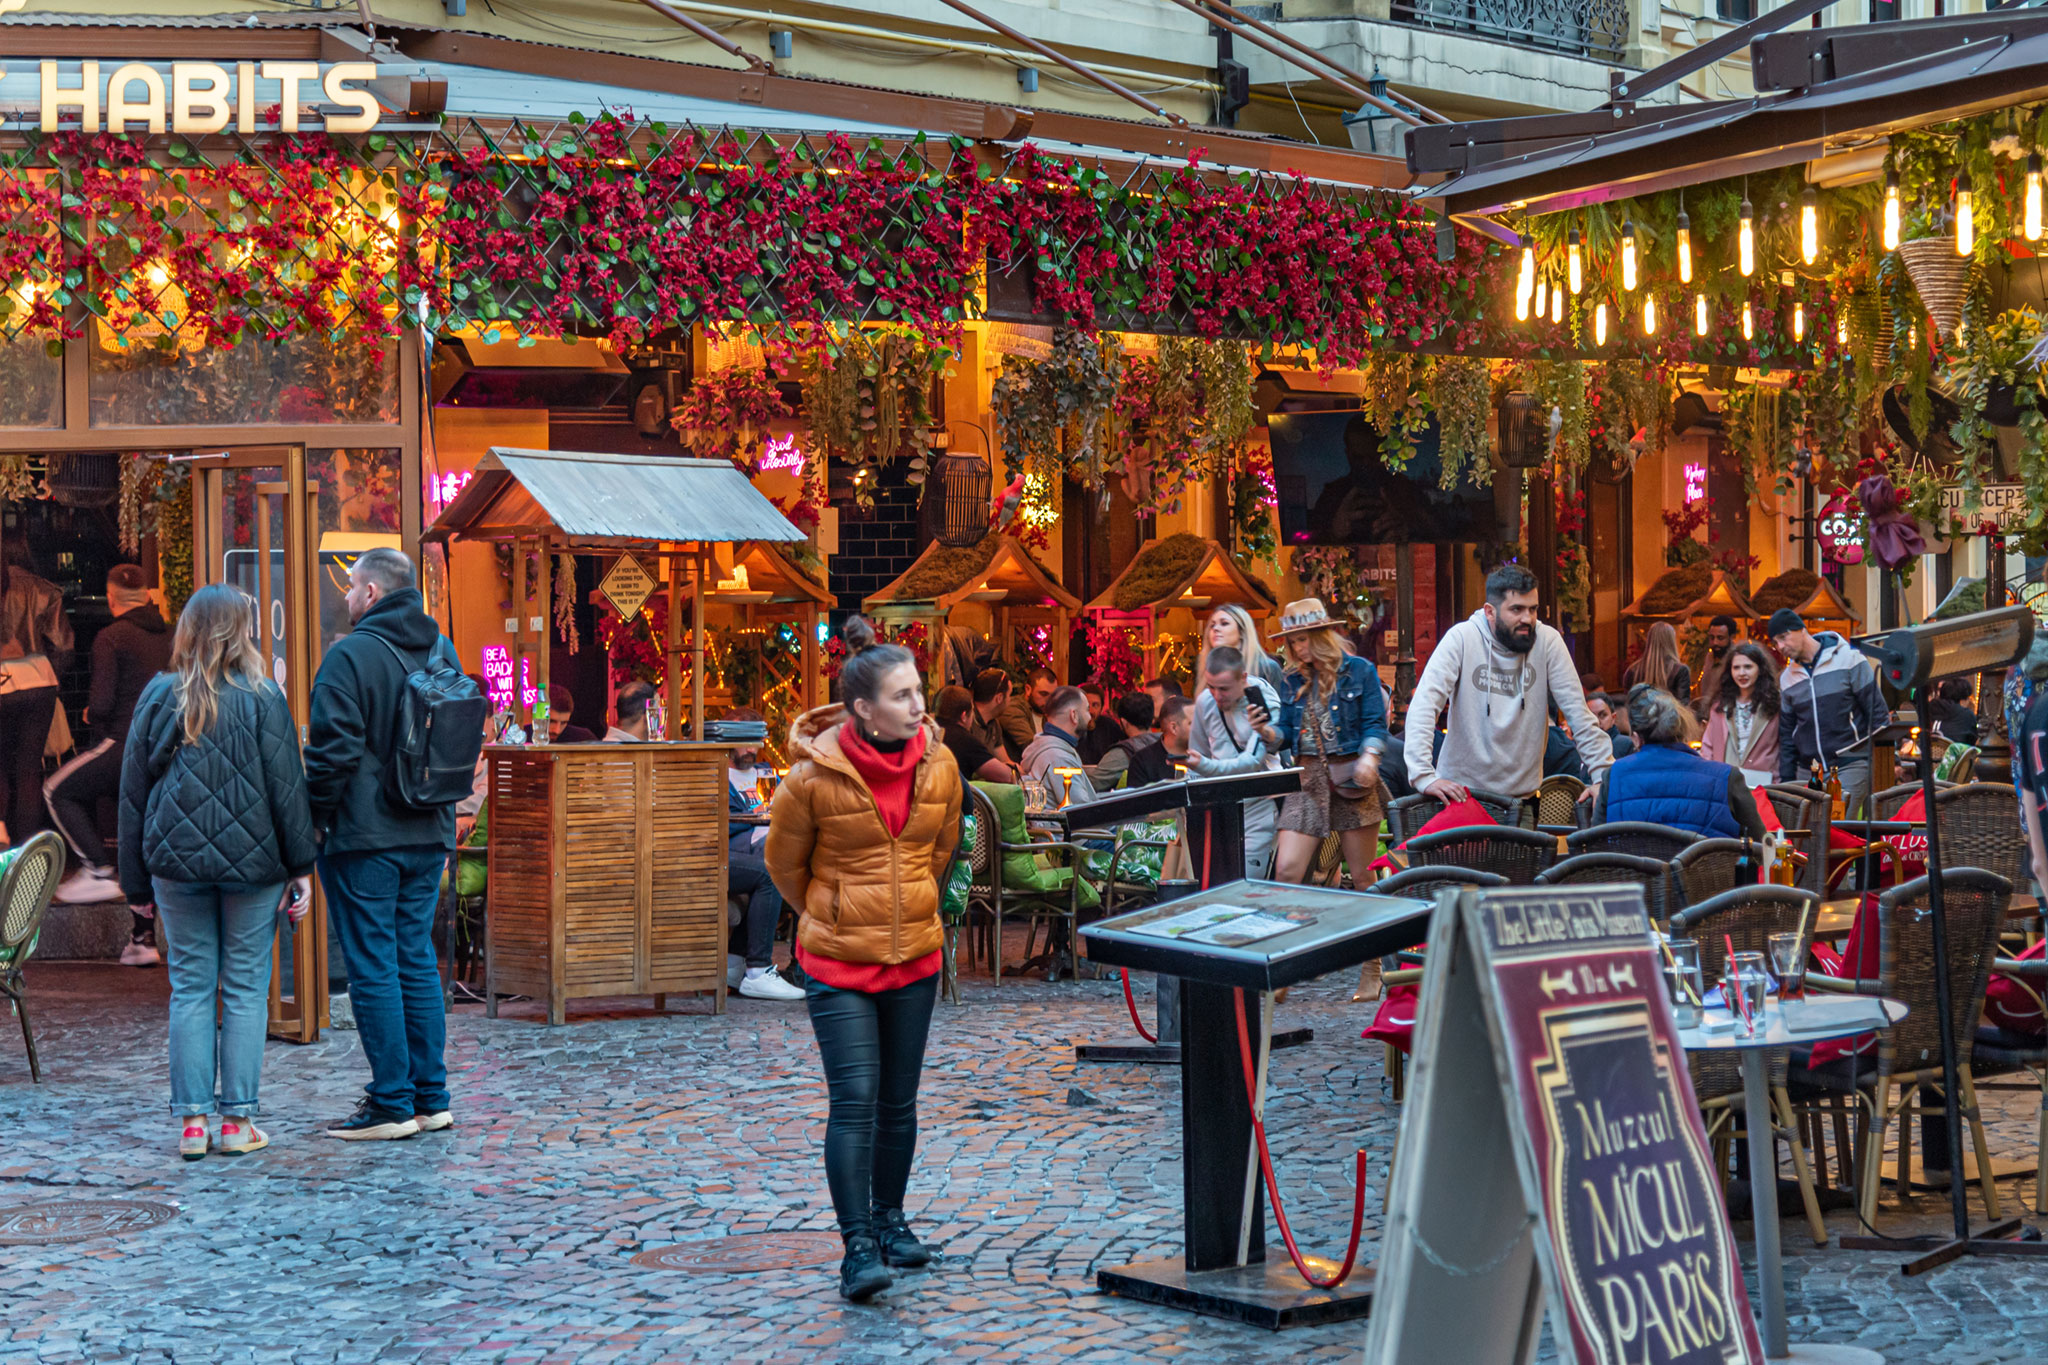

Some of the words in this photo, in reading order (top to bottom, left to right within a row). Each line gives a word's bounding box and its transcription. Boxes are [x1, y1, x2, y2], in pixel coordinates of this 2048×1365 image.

[41, 59, 381, 134] HABITS
[486, 647, 499, 661] BE
[1574, 1091, 1675, 1161] Muzeul
